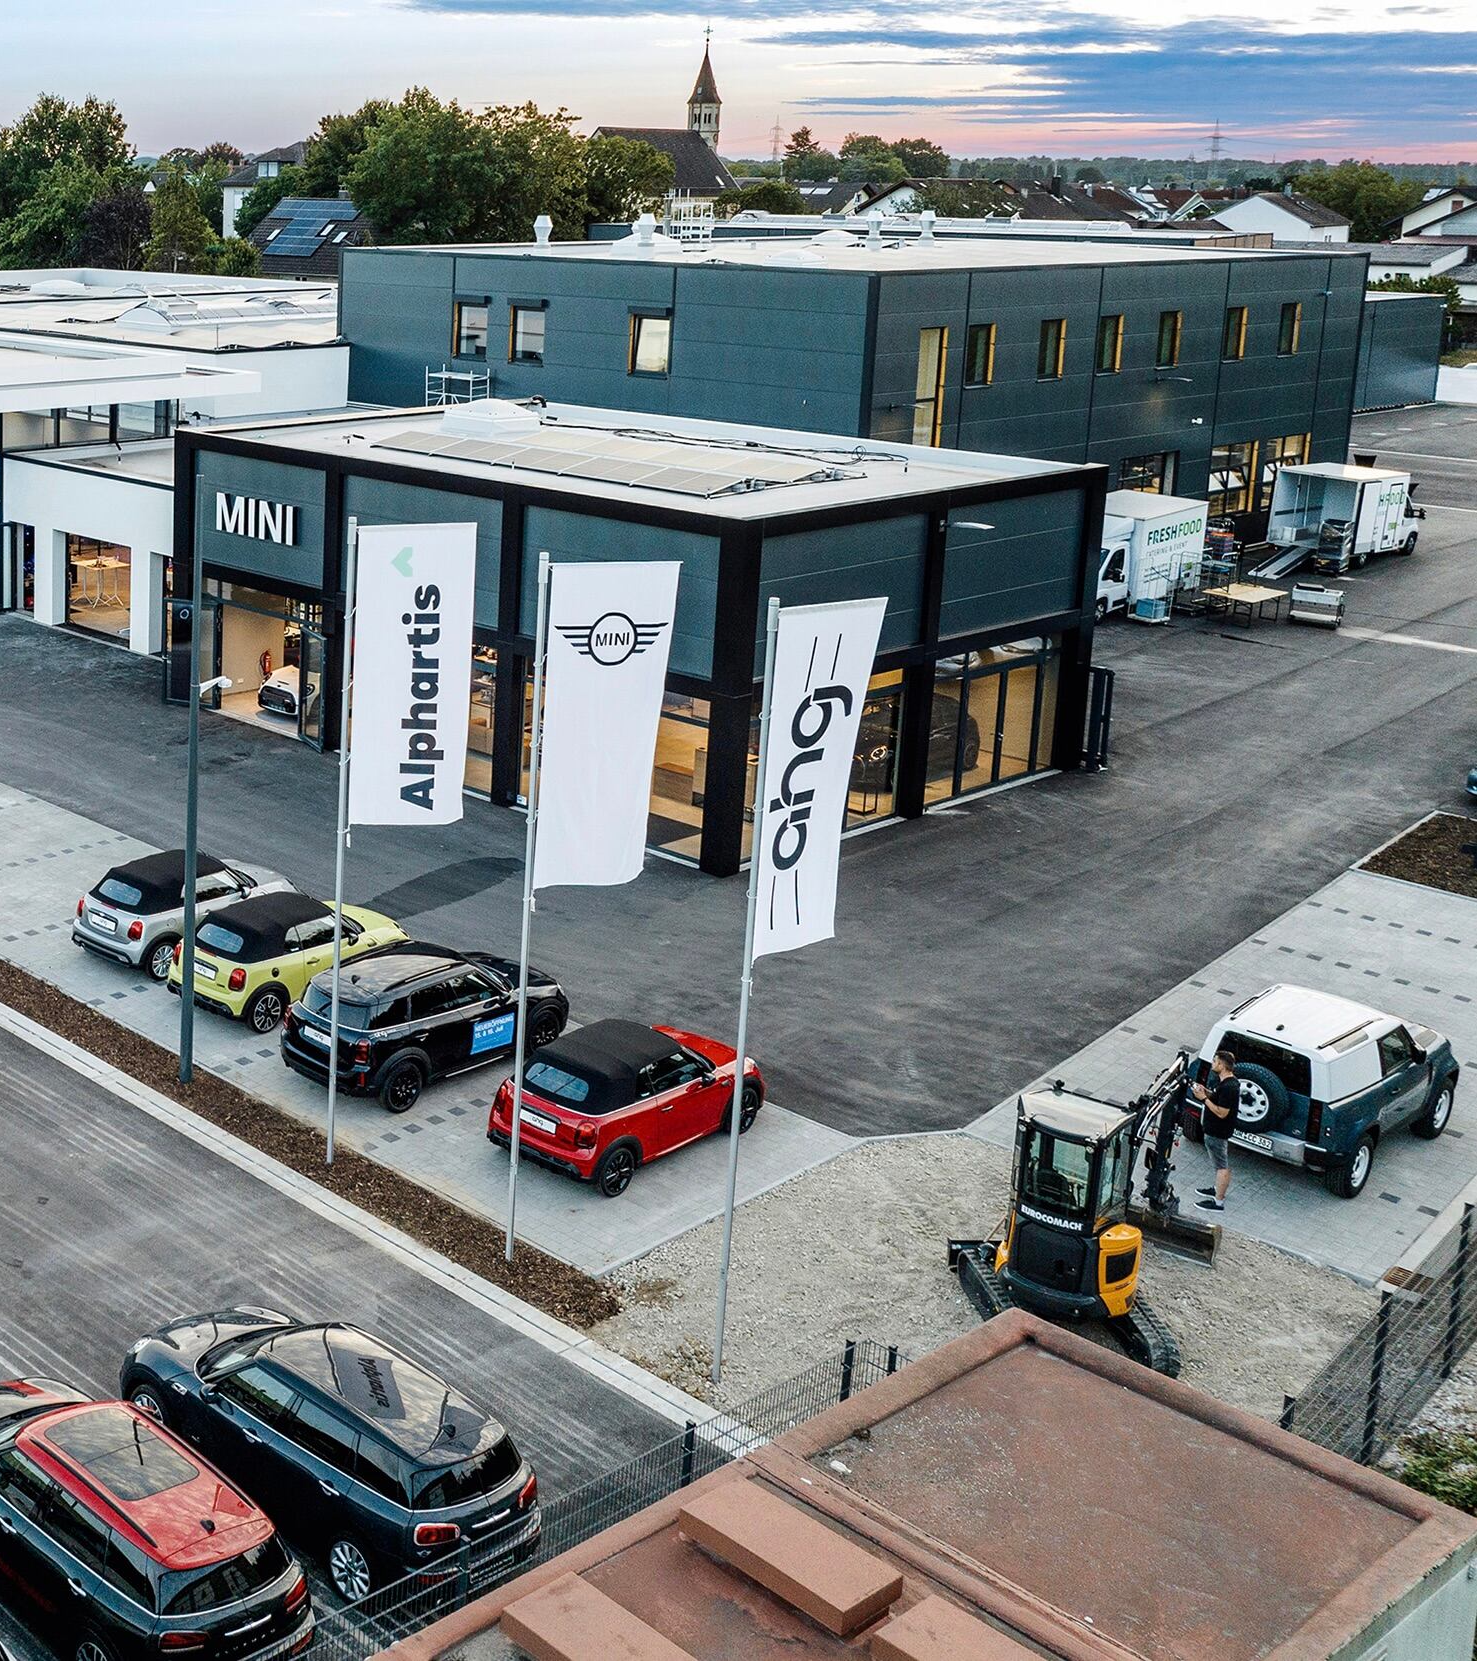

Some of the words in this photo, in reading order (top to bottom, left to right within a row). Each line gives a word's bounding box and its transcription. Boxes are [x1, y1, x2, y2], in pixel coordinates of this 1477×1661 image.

[216, 491, 293, 546] MINI
[595, 631, 630, 647] MINI
[399, 583, 445, 811] Alphartis
[771, 684, 853, 871] ahg
[1021, 1204, 1082, 1231] EUROCOMACH
